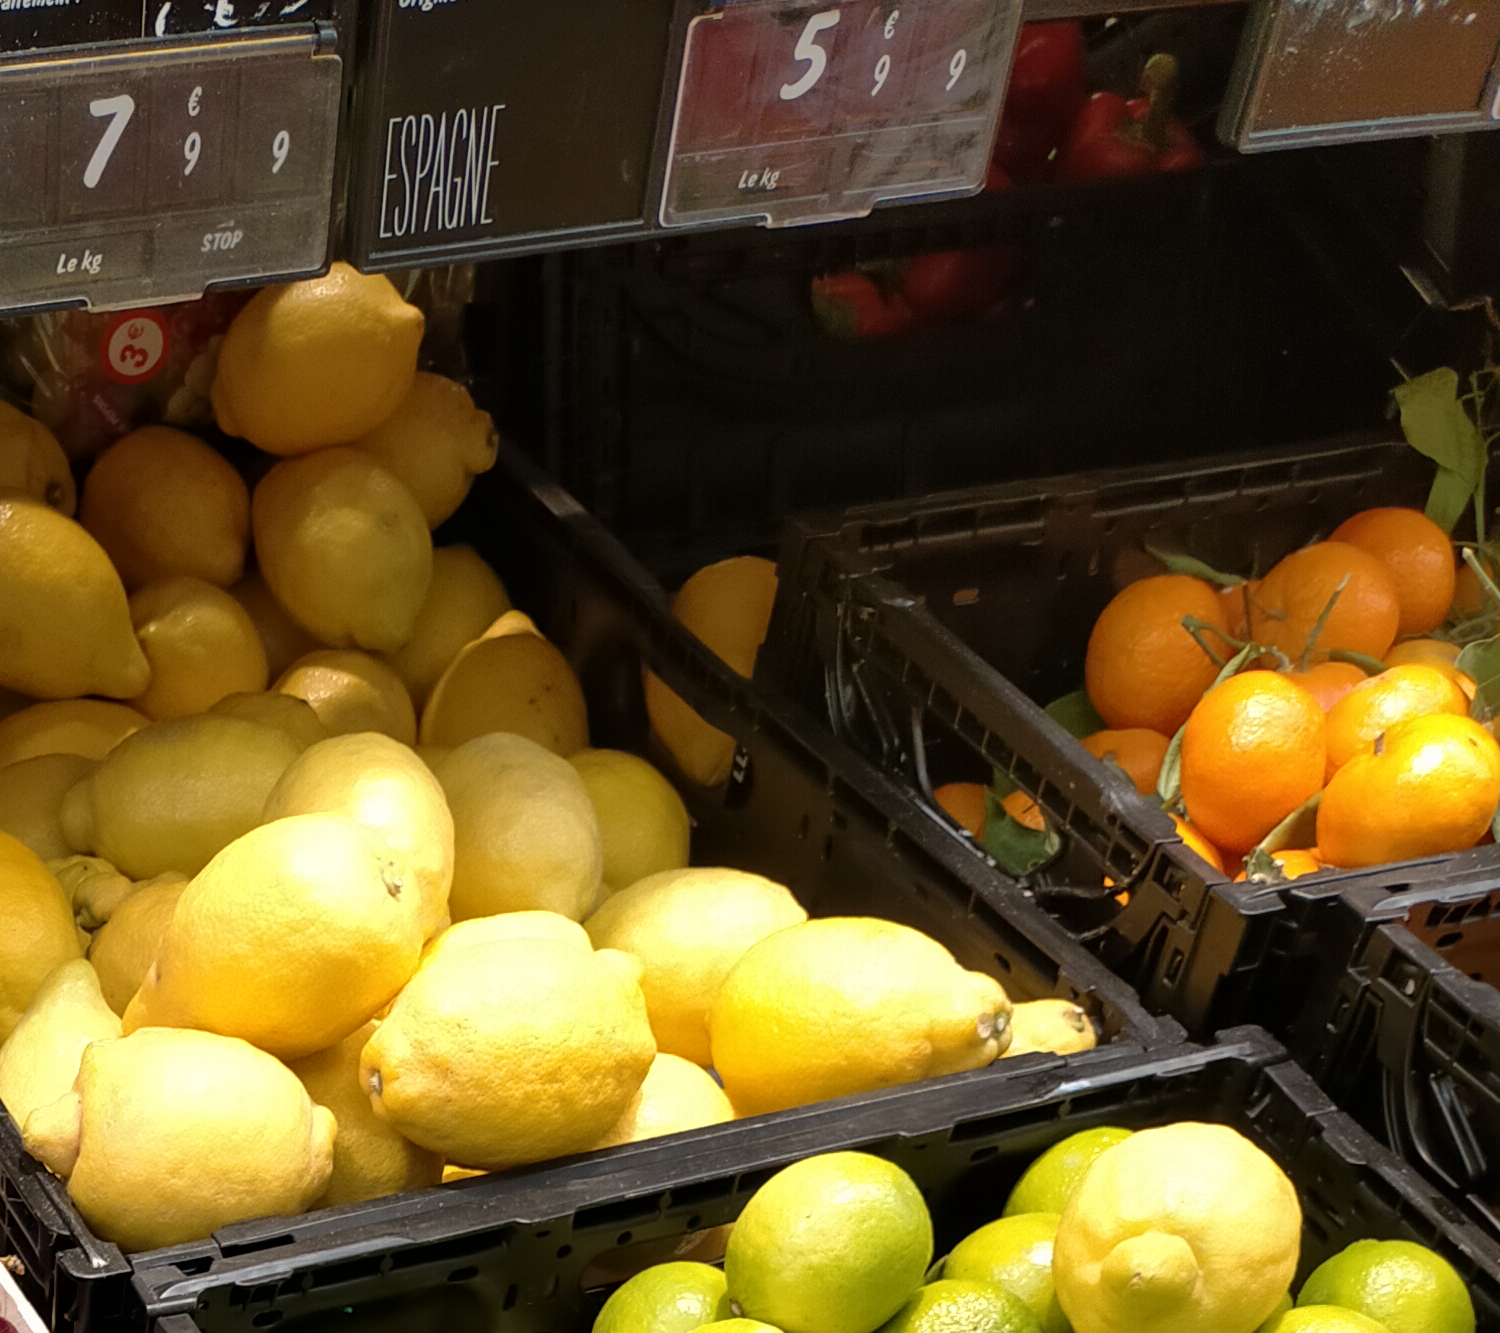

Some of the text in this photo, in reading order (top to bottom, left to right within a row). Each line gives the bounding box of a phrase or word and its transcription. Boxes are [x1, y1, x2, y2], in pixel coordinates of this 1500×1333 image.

[779, 8, 840, 100] 5
[871, 54, 891, 96] 9
[946, 49, 967, 91] 9
[83, 94, 135, 188] 7
[184, 131, 201, 176] 9
[272, 130, 290, 174] 9
[379, 104, 506, 238] ESPAGNE
[738, 168, 780, 189] Le kg
[56, 250, 102, 274] Le kg
[201, 230, 244, 252] STOP
